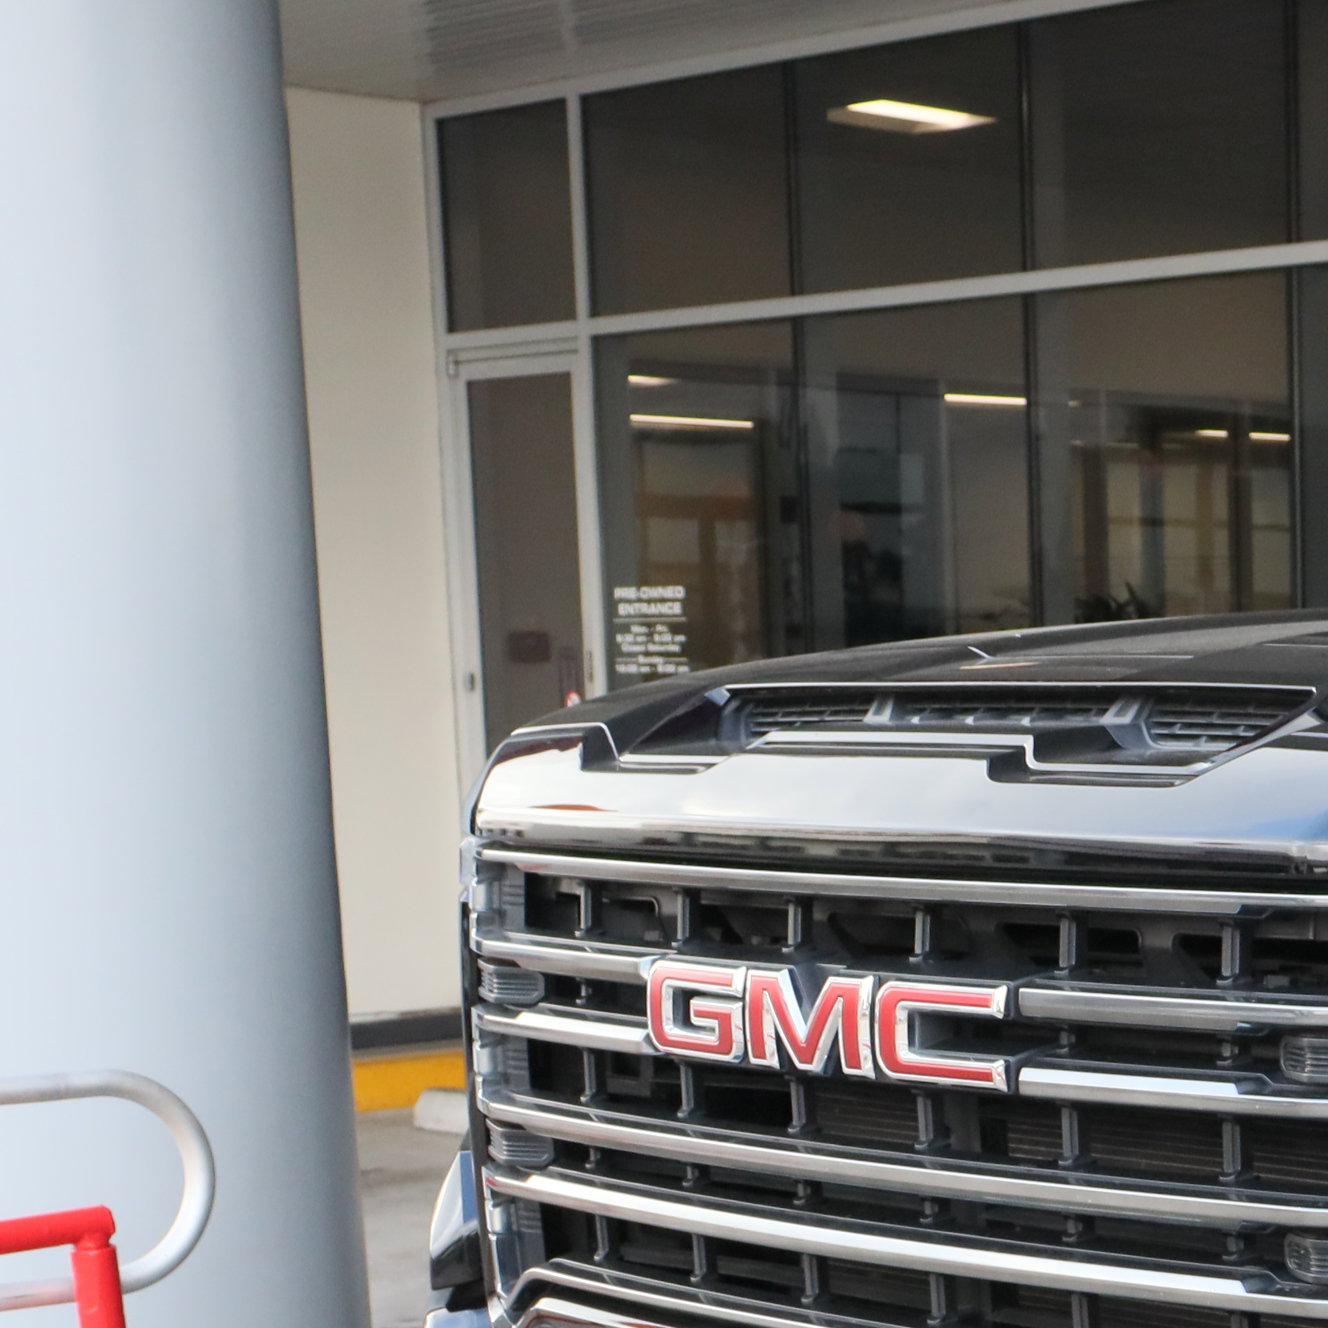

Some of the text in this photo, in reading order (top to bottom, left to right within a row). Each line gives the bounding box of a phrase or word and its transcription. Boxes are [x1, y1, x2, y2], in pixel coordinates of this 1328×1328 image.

[614, 585, 686, 600] PRE-OWNED
[617, 601, 682, 616] ENTRANCE
[647, 958, 1008, 1093] GMC
